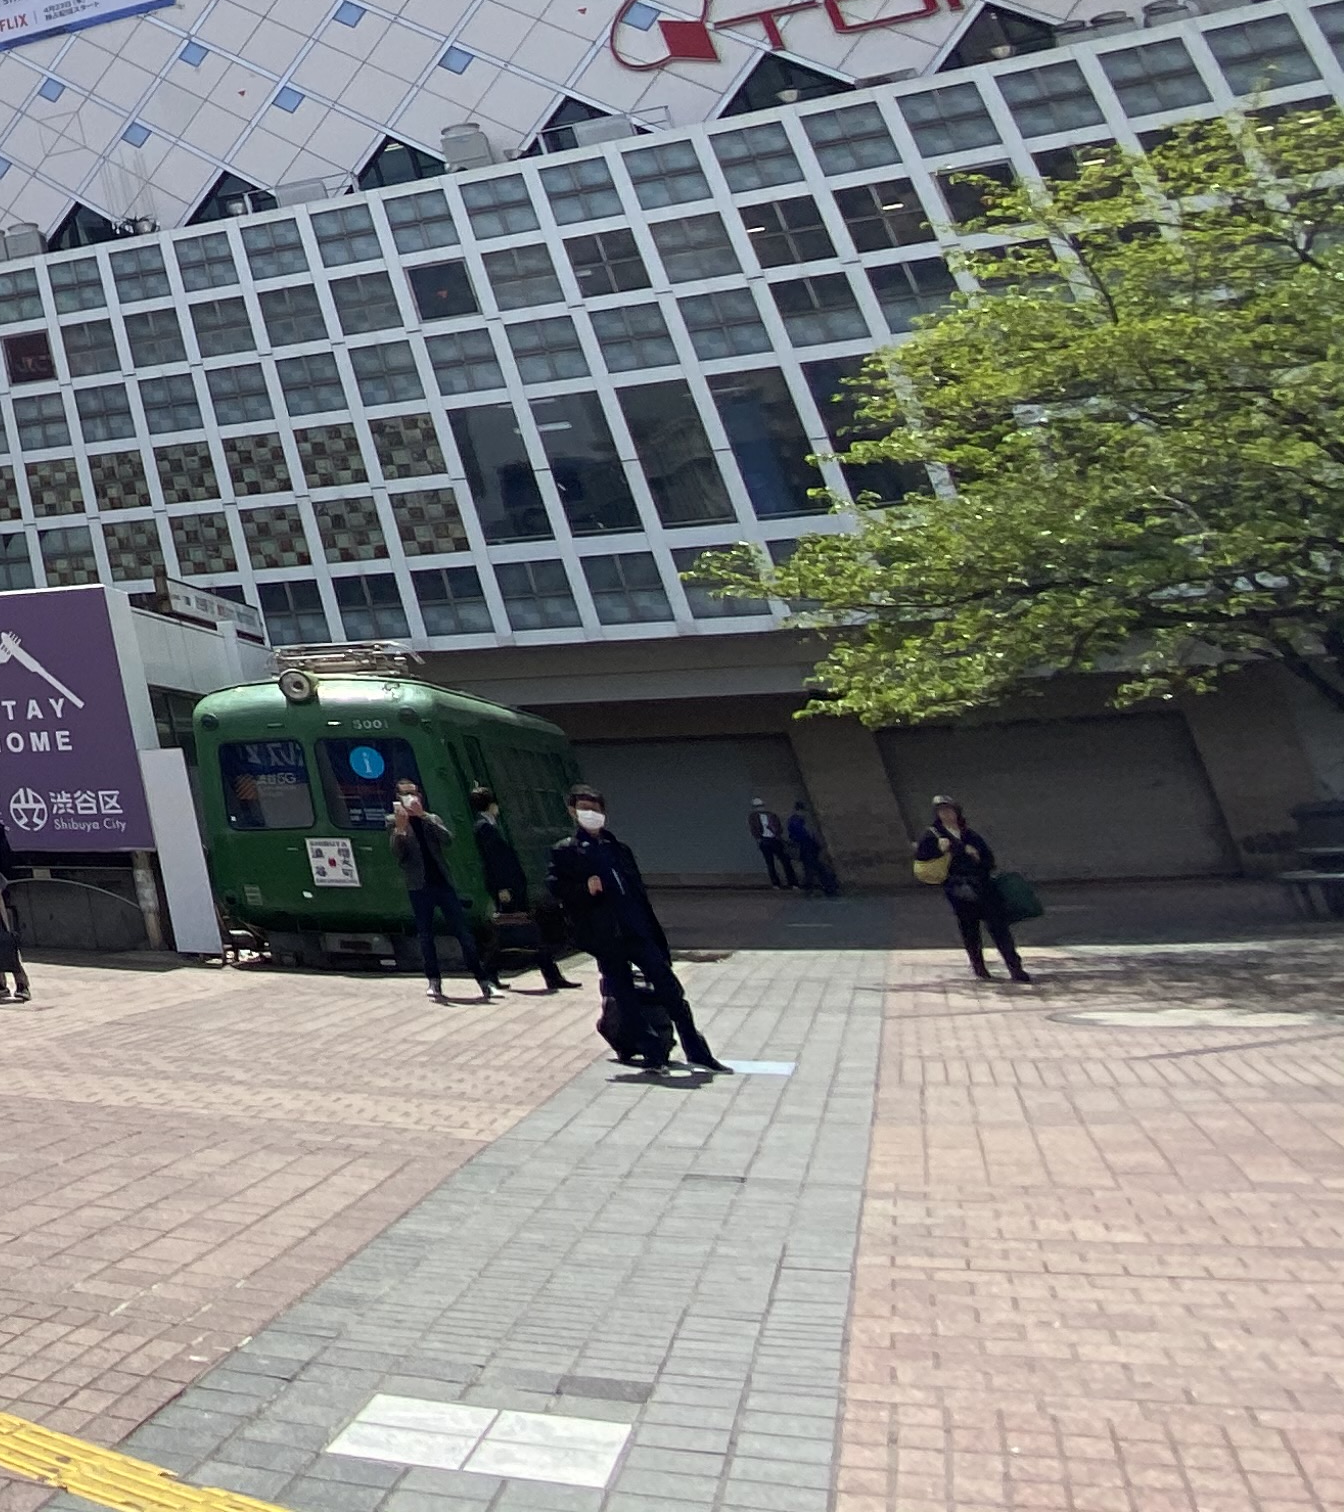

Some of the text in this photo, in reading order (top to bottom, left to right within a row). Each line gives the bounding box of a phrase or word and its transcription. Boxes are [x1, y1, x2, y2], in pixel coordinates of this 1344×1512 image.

[49, 790, 123, 815] 渋谷区
[54, 817, 128, 833] Shibuya City
